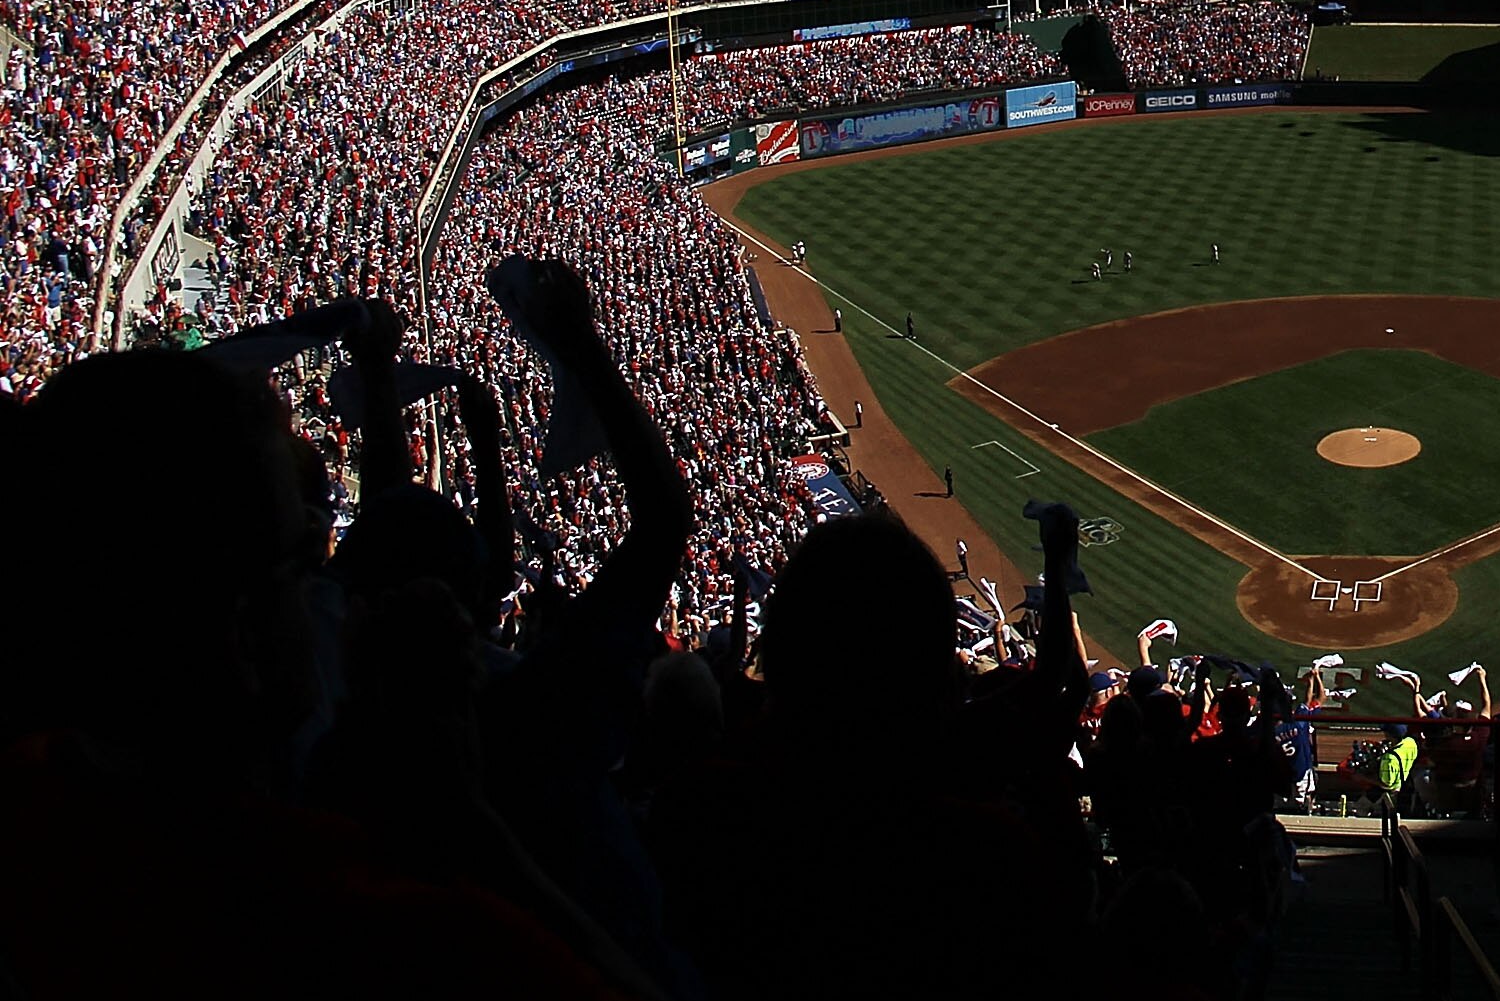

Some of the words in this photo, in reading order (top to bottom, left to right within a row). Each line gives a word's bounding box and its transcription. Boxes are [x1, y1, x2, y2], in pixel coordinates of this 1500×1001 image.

[1145, 95, 1196, 107] GEICO
[1209, 91, 1258, 103] SAMSUNG
[1260, 91, 1291, 100] mobile
[1009, 104, 1074, 120] SOUTHWEST.COM
[1085, 99, 1135, 112] JCPenney
[760, 119, 799, 164] Budweiser
[1281, 740, 1296, 756] 5
